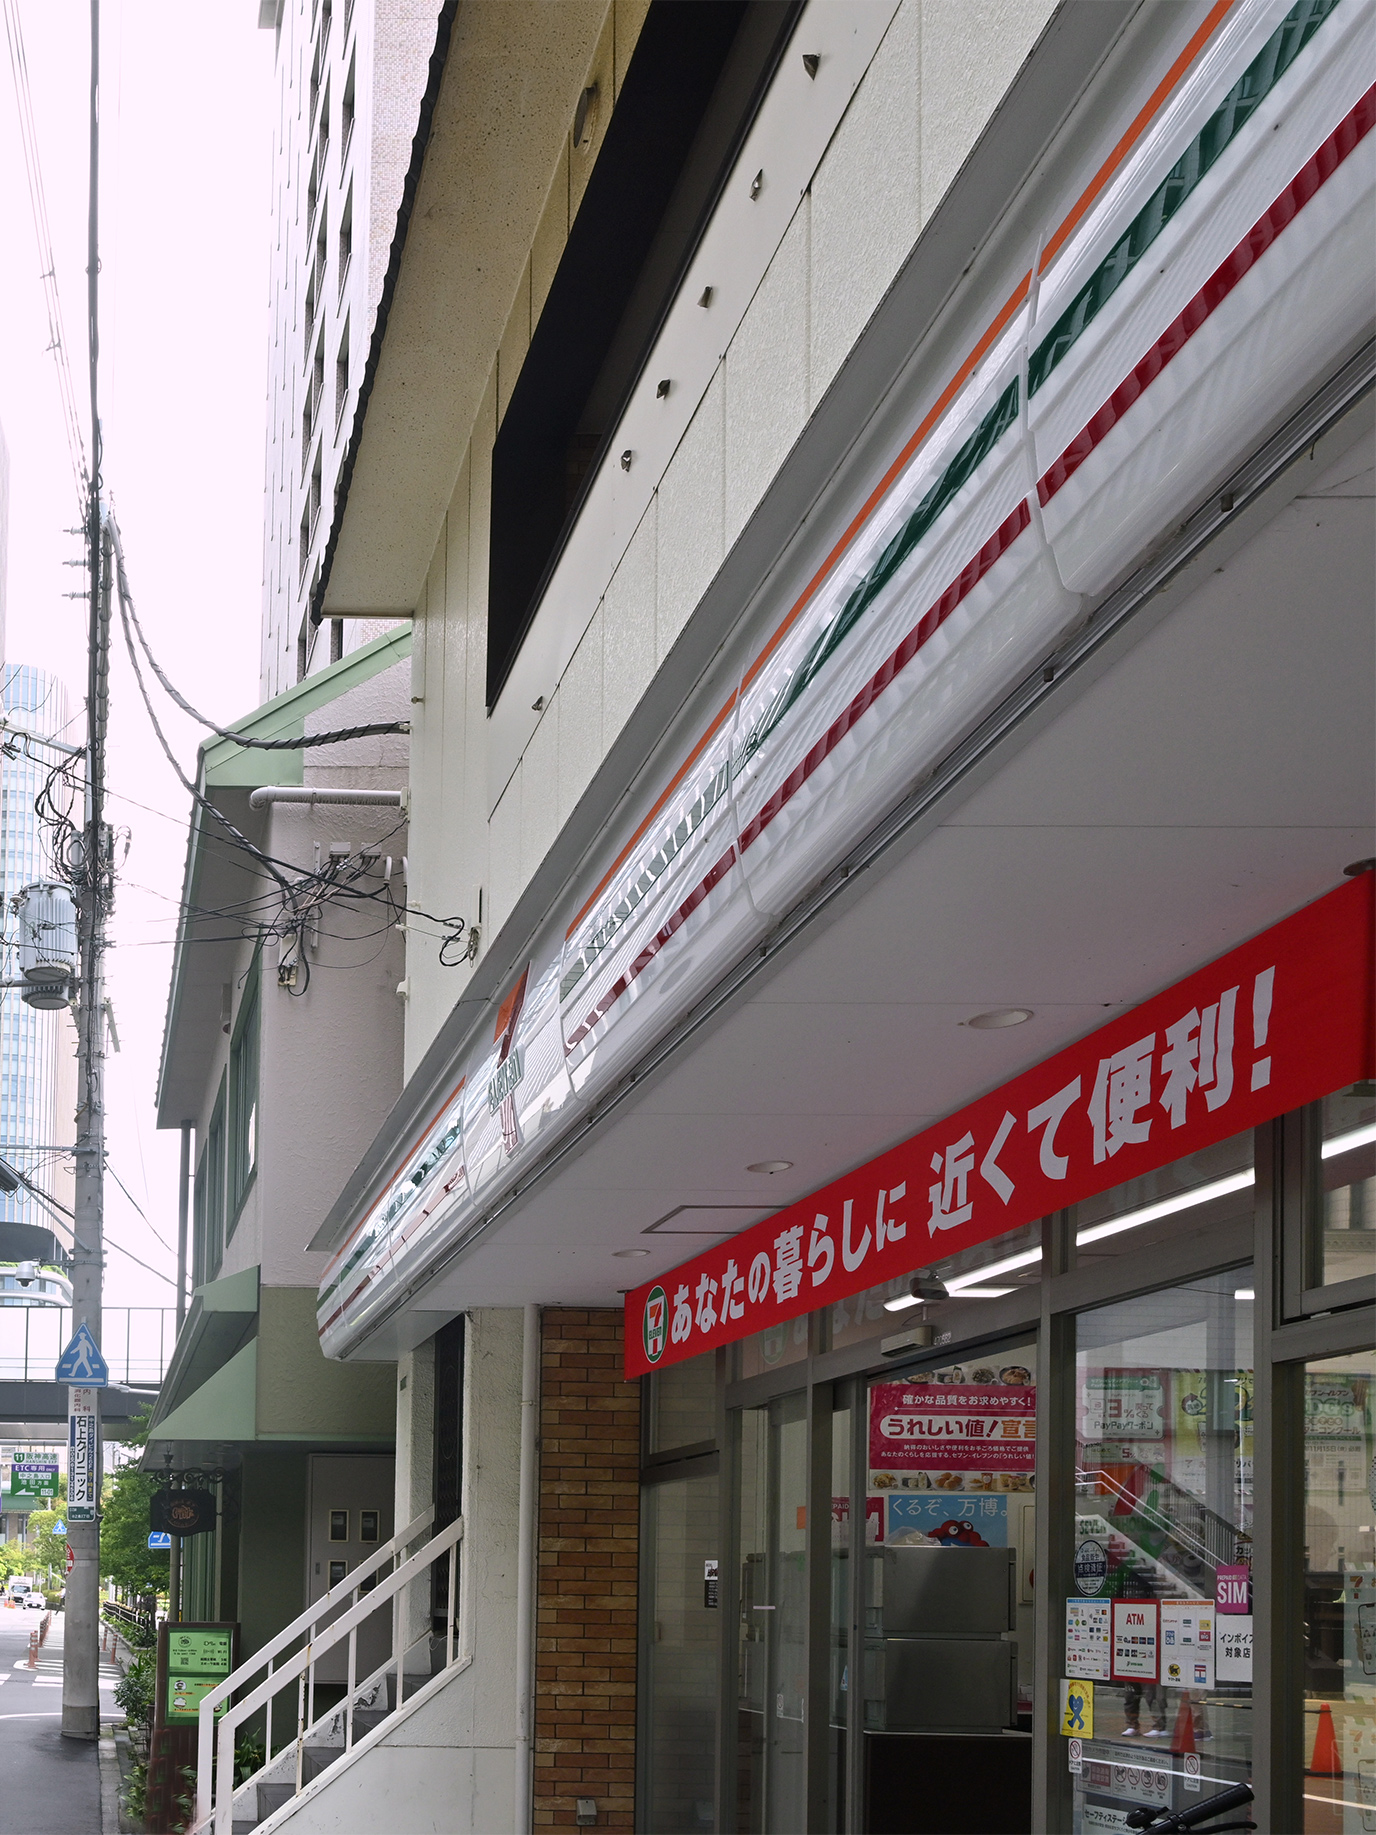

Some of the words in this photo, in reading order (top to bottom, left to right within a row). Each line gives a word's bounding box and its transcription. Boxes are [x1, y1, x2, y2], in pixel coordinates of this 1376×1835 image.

[671, 1181, 906, 1344] あなたの暮らしに
[927, 965, 1275, 1238] 近くて便利!
[902, 1394, 1031, 1406] 確かな品質をお求めやすく!
[1094, 1421, 1154, 1430] PayPayクーポン
[76, 1416, 87, 1501] 石上クリニック
[892, 1498, 1007, 1518] くるぞ、万博。
[1078, 1563, 1102, 1572] 点検済証
[1217, 1581, 1247, 1604] SIM
[1126, 1614, 1144, 1625] ATM
[1225, 1647, 1250, 1658] 対象店
[1085, 1810, 1126, 1824] セーフティステー
